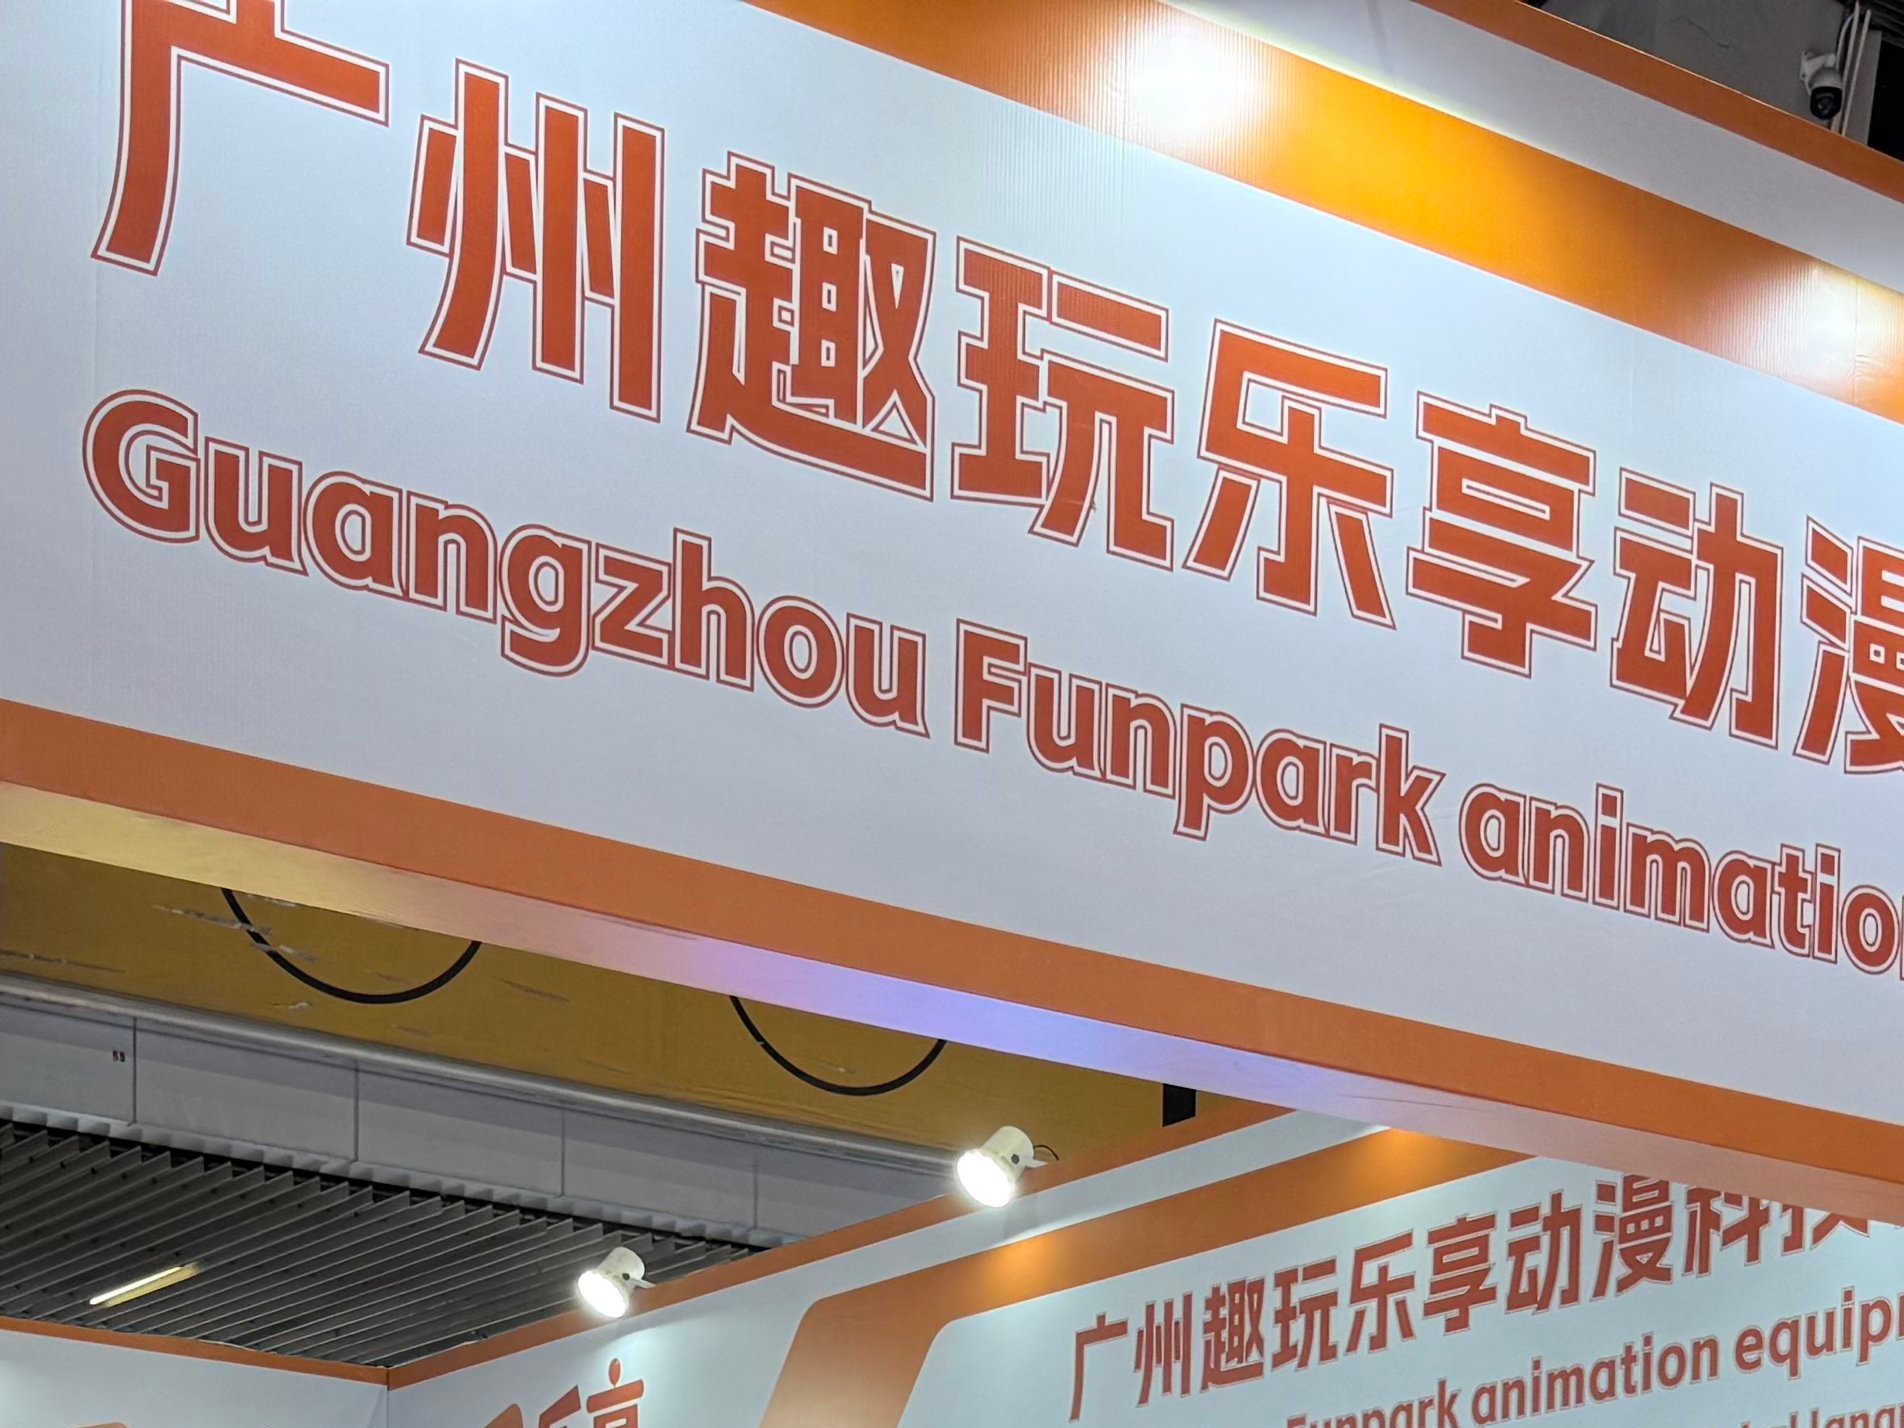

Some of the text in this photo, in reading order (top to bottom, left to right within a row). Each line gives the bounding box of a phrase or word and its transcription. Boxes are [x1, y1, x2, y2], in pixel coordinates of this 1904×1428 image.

[82, 388, 930, 737] Guangzhou
[954, 617, 1445, 868] Funpark
[1469, 1332, 1719, 1428] animation
